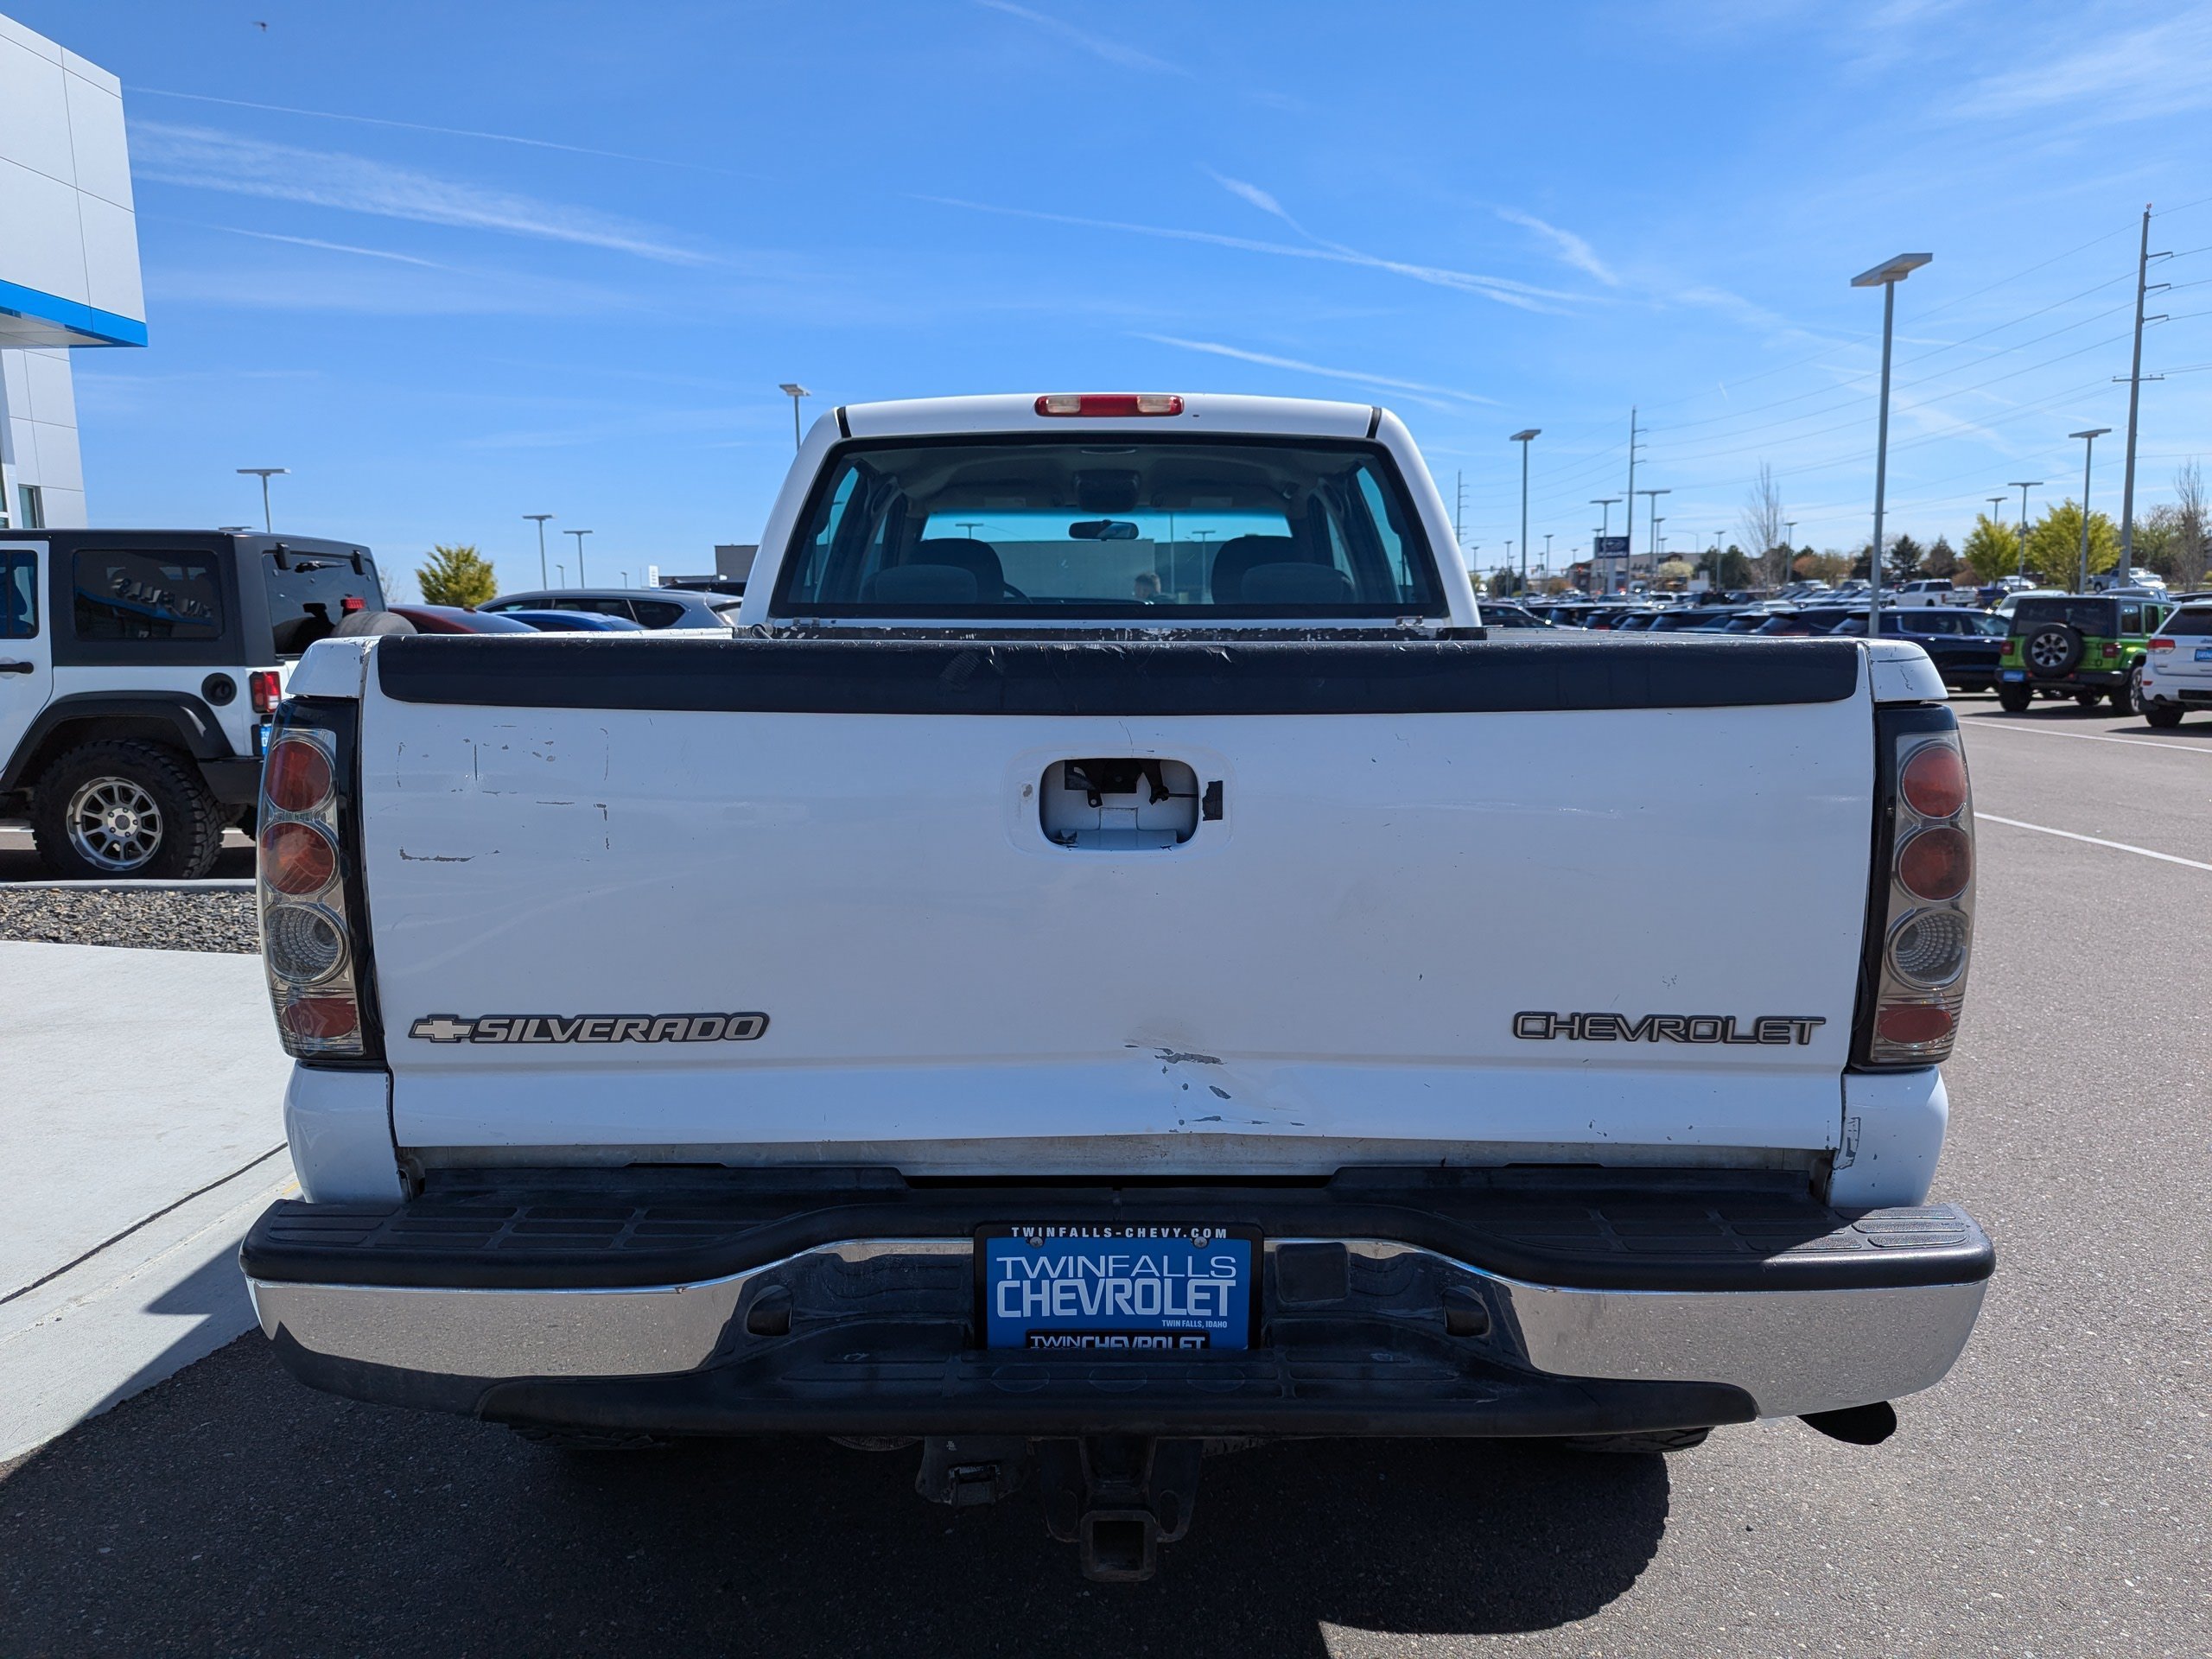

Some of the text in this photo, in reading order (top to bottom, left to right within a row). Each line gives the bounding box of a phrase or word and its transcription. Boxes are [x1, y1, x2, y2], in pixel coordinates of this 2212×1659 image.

[471, 1014, 768, 1043] SILVERADO
[1514, 1012, 1826, 1045] CHEVROLET
[1011, 1227, 1227, 1239] TWINFALLS-CHEVY.COM
[997, 1278, 1236, 1318] CHEVROLET
[1161, 1319, 1181, 1328] TWIN
[1181, 1319, 1205, 1330] FALLS,
